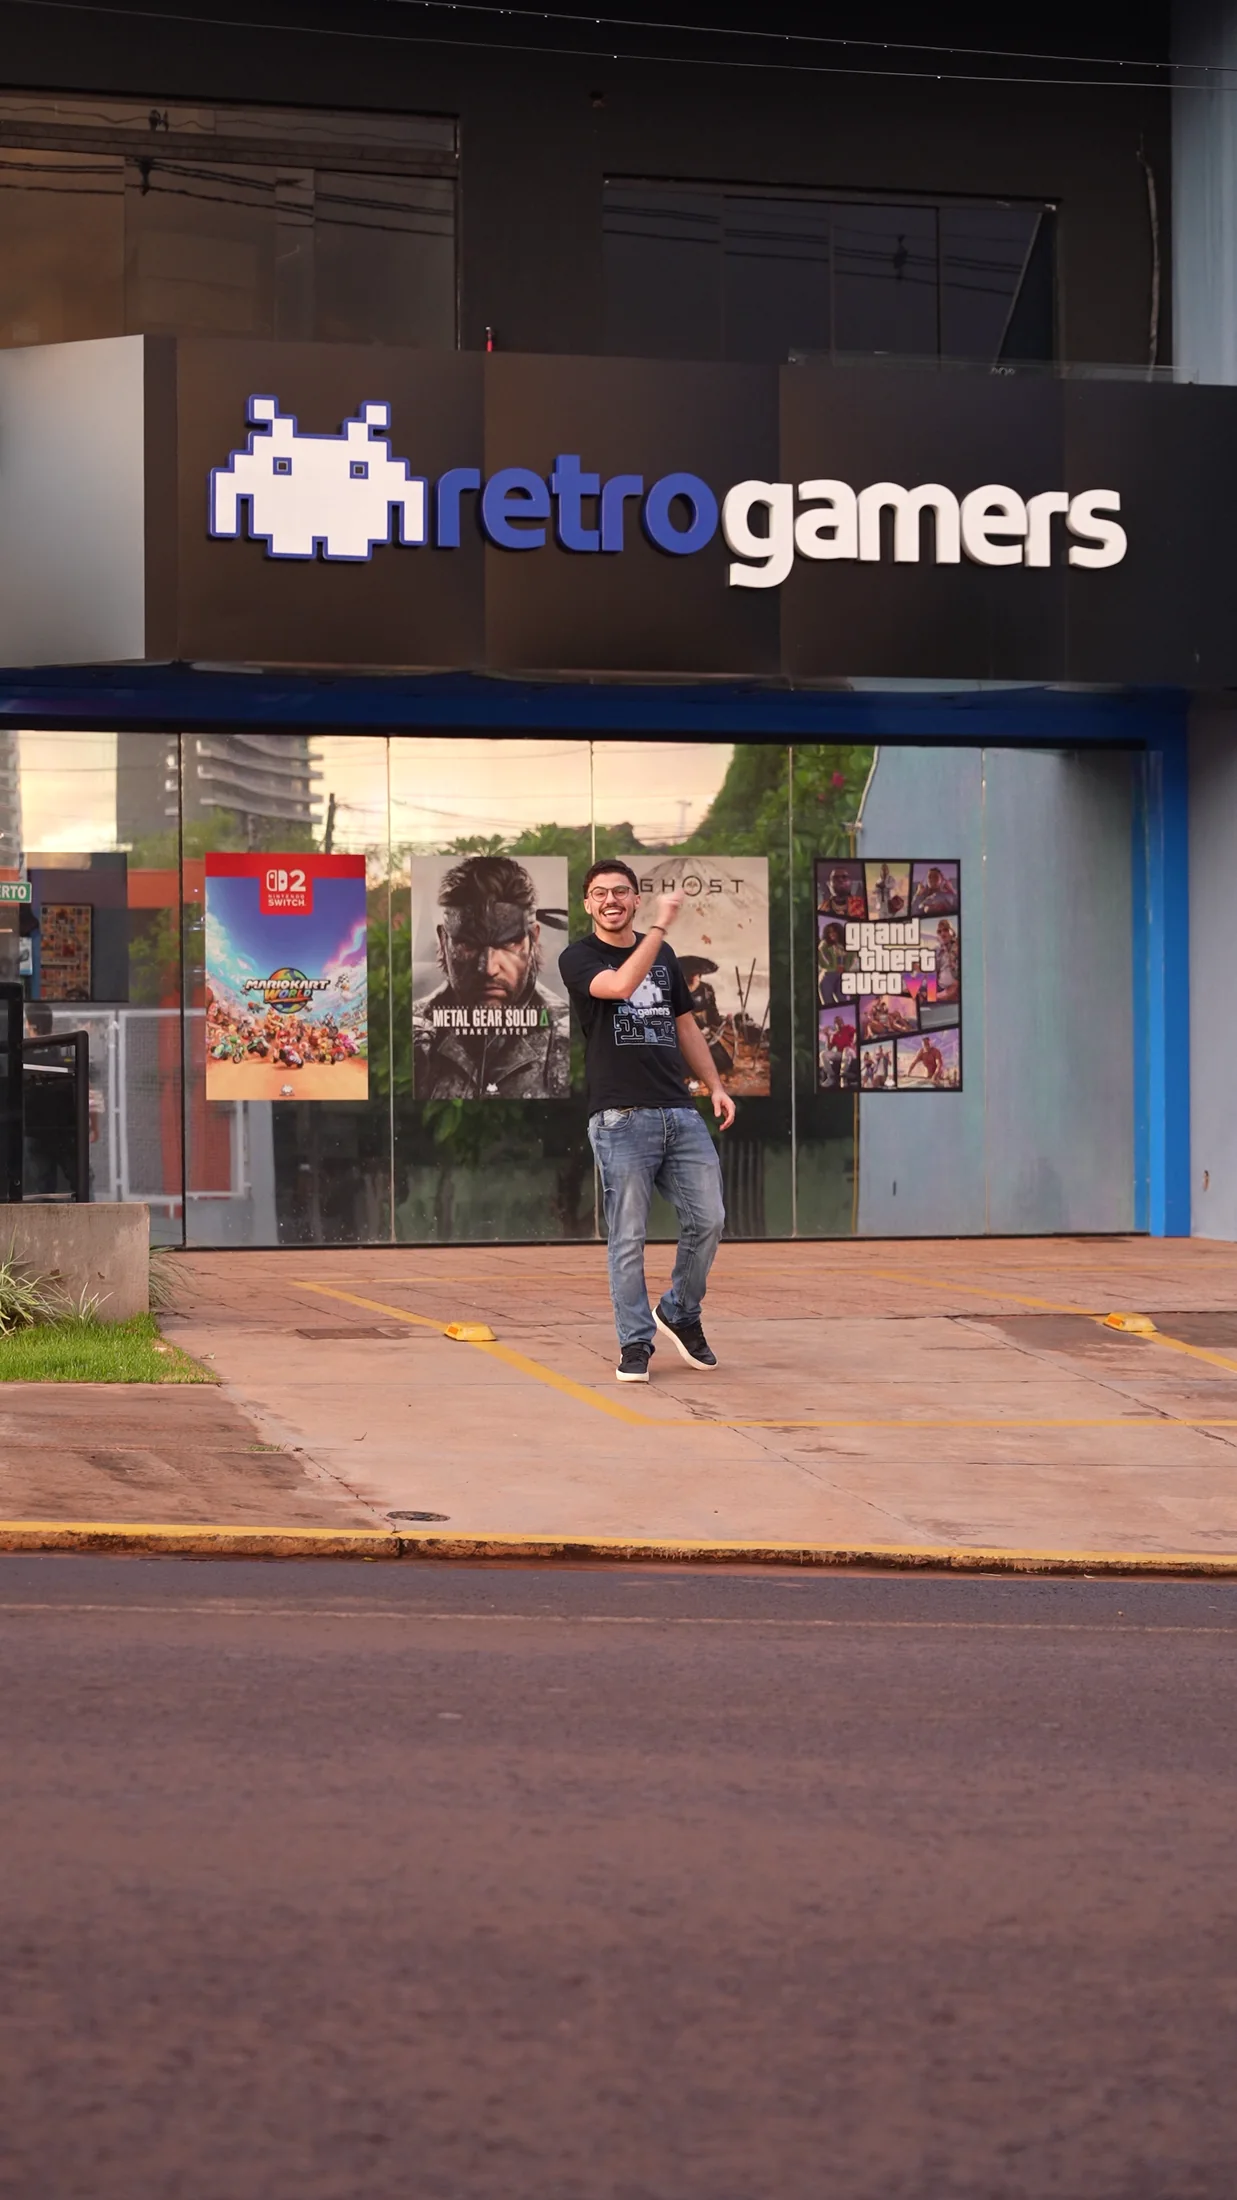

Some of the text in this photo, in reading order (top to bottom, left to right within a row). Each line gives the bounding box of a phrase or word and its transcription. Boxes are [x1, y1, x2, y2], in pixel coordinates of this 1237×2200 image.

[436, 453, 1127, 589] retrogamers
[289, 869, 306, 892] 2
[640, 875, 744, 897] GHOST
[268, 899, 305, 907] SWITCH
[264, 989, 312, 1001] WORLD
[841, 972, 937, 1002] auto VI
[432, 1009, 470, 1027] METAL
[472, 1009, 503, 1027] GEAR
[505, 1009, 537, 1027] SOLID
[455, 1028, 528, 1036] SNAKE EATER
